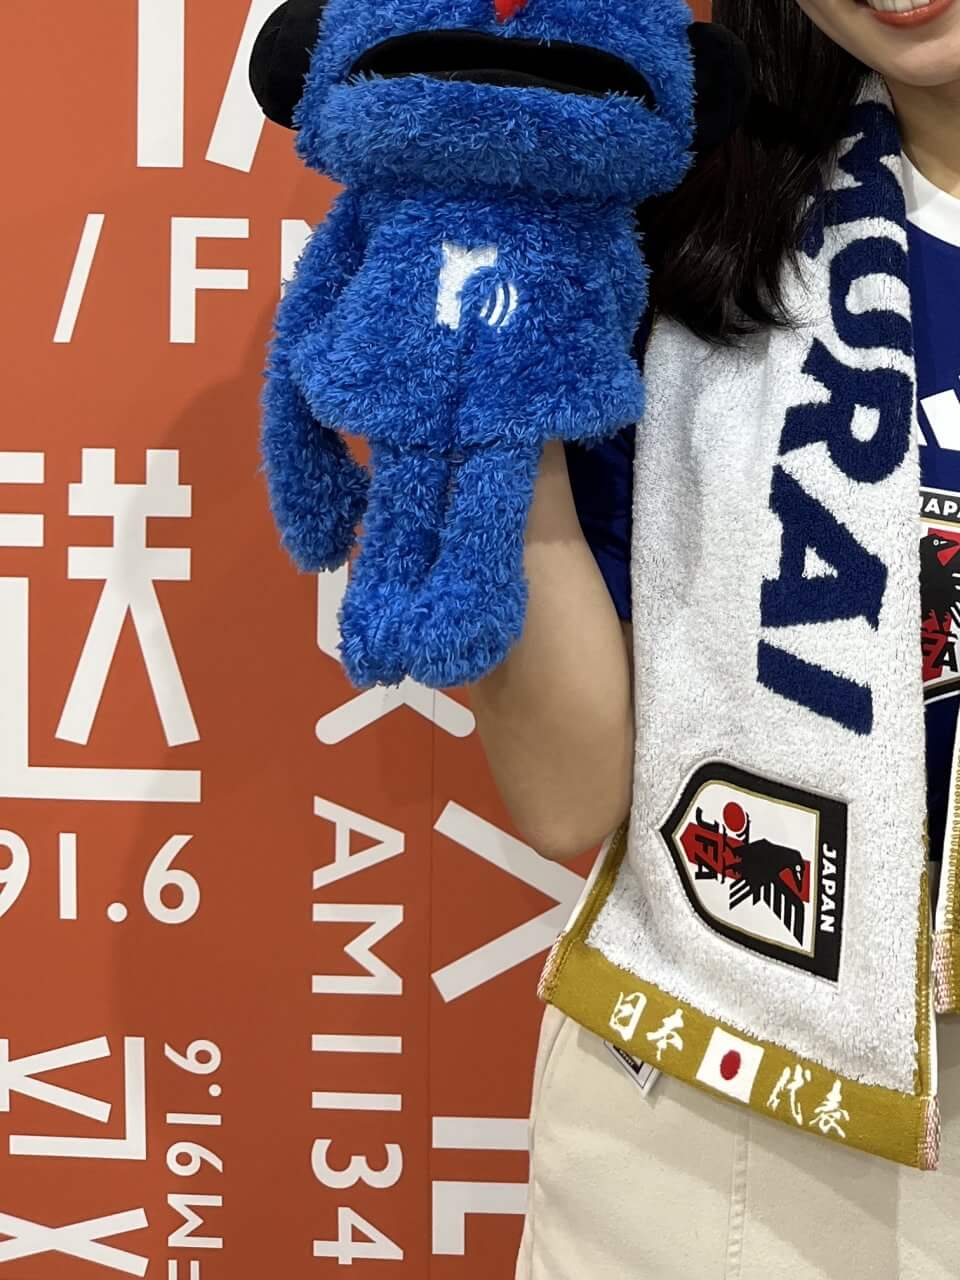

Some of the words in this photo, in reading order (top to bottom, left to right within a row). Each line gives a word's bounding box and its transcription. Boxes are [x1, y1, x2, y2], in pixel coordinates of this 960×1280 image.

[819, 842, 838, 934] JAPAN
[311, 796, 405, 1265] AM1134
[608, 990, 684, 1061] 日本
[766, 1063, 851, 1139] 代表
